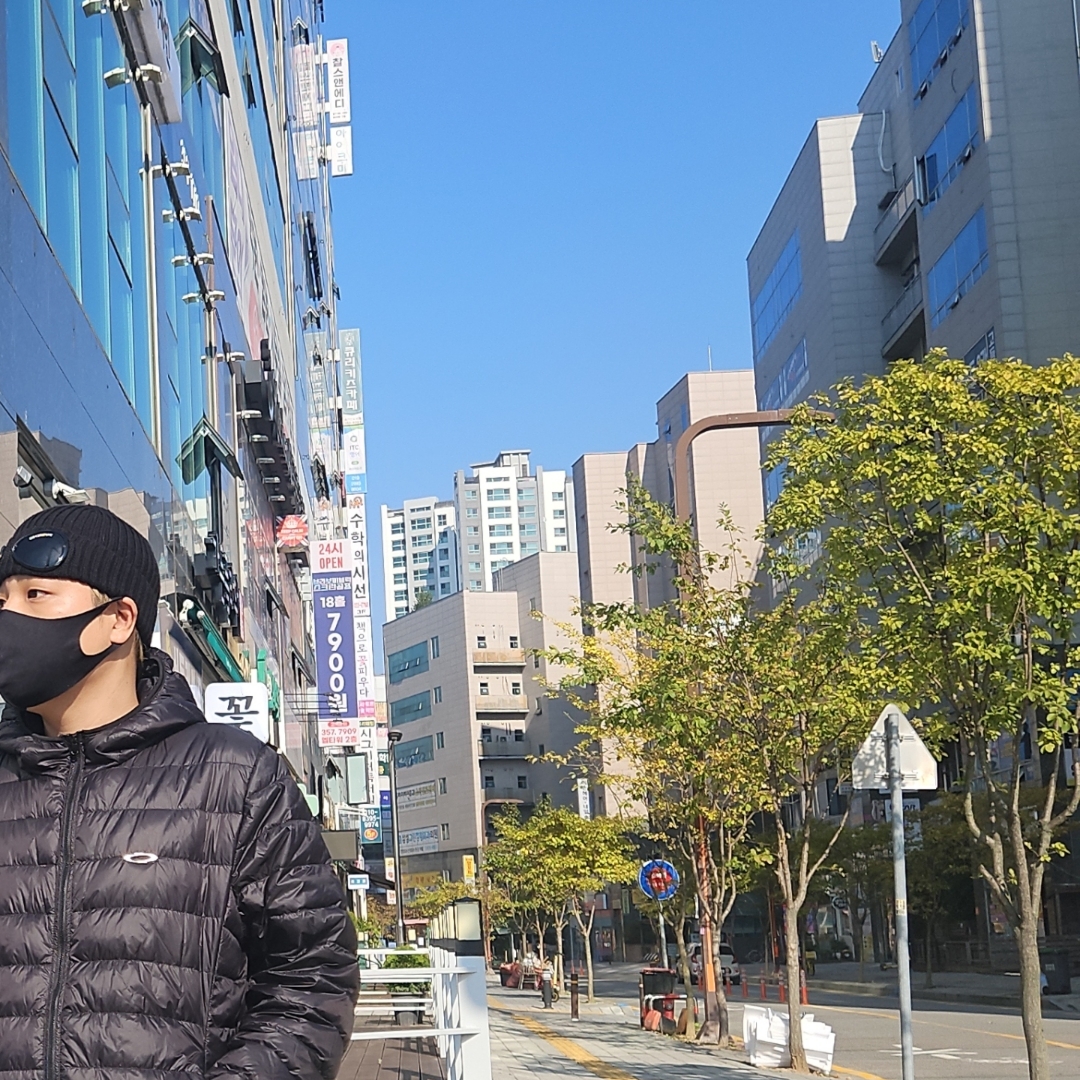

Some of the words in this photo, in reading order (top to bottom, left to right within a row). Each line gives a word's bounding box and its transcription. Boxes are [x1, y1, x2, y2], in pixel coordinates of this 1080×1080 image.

[318, 542, 343, 555] 24시
[319, 556, 344, 570] OPEN
[349, 513, 367, 599] 수학의시선
